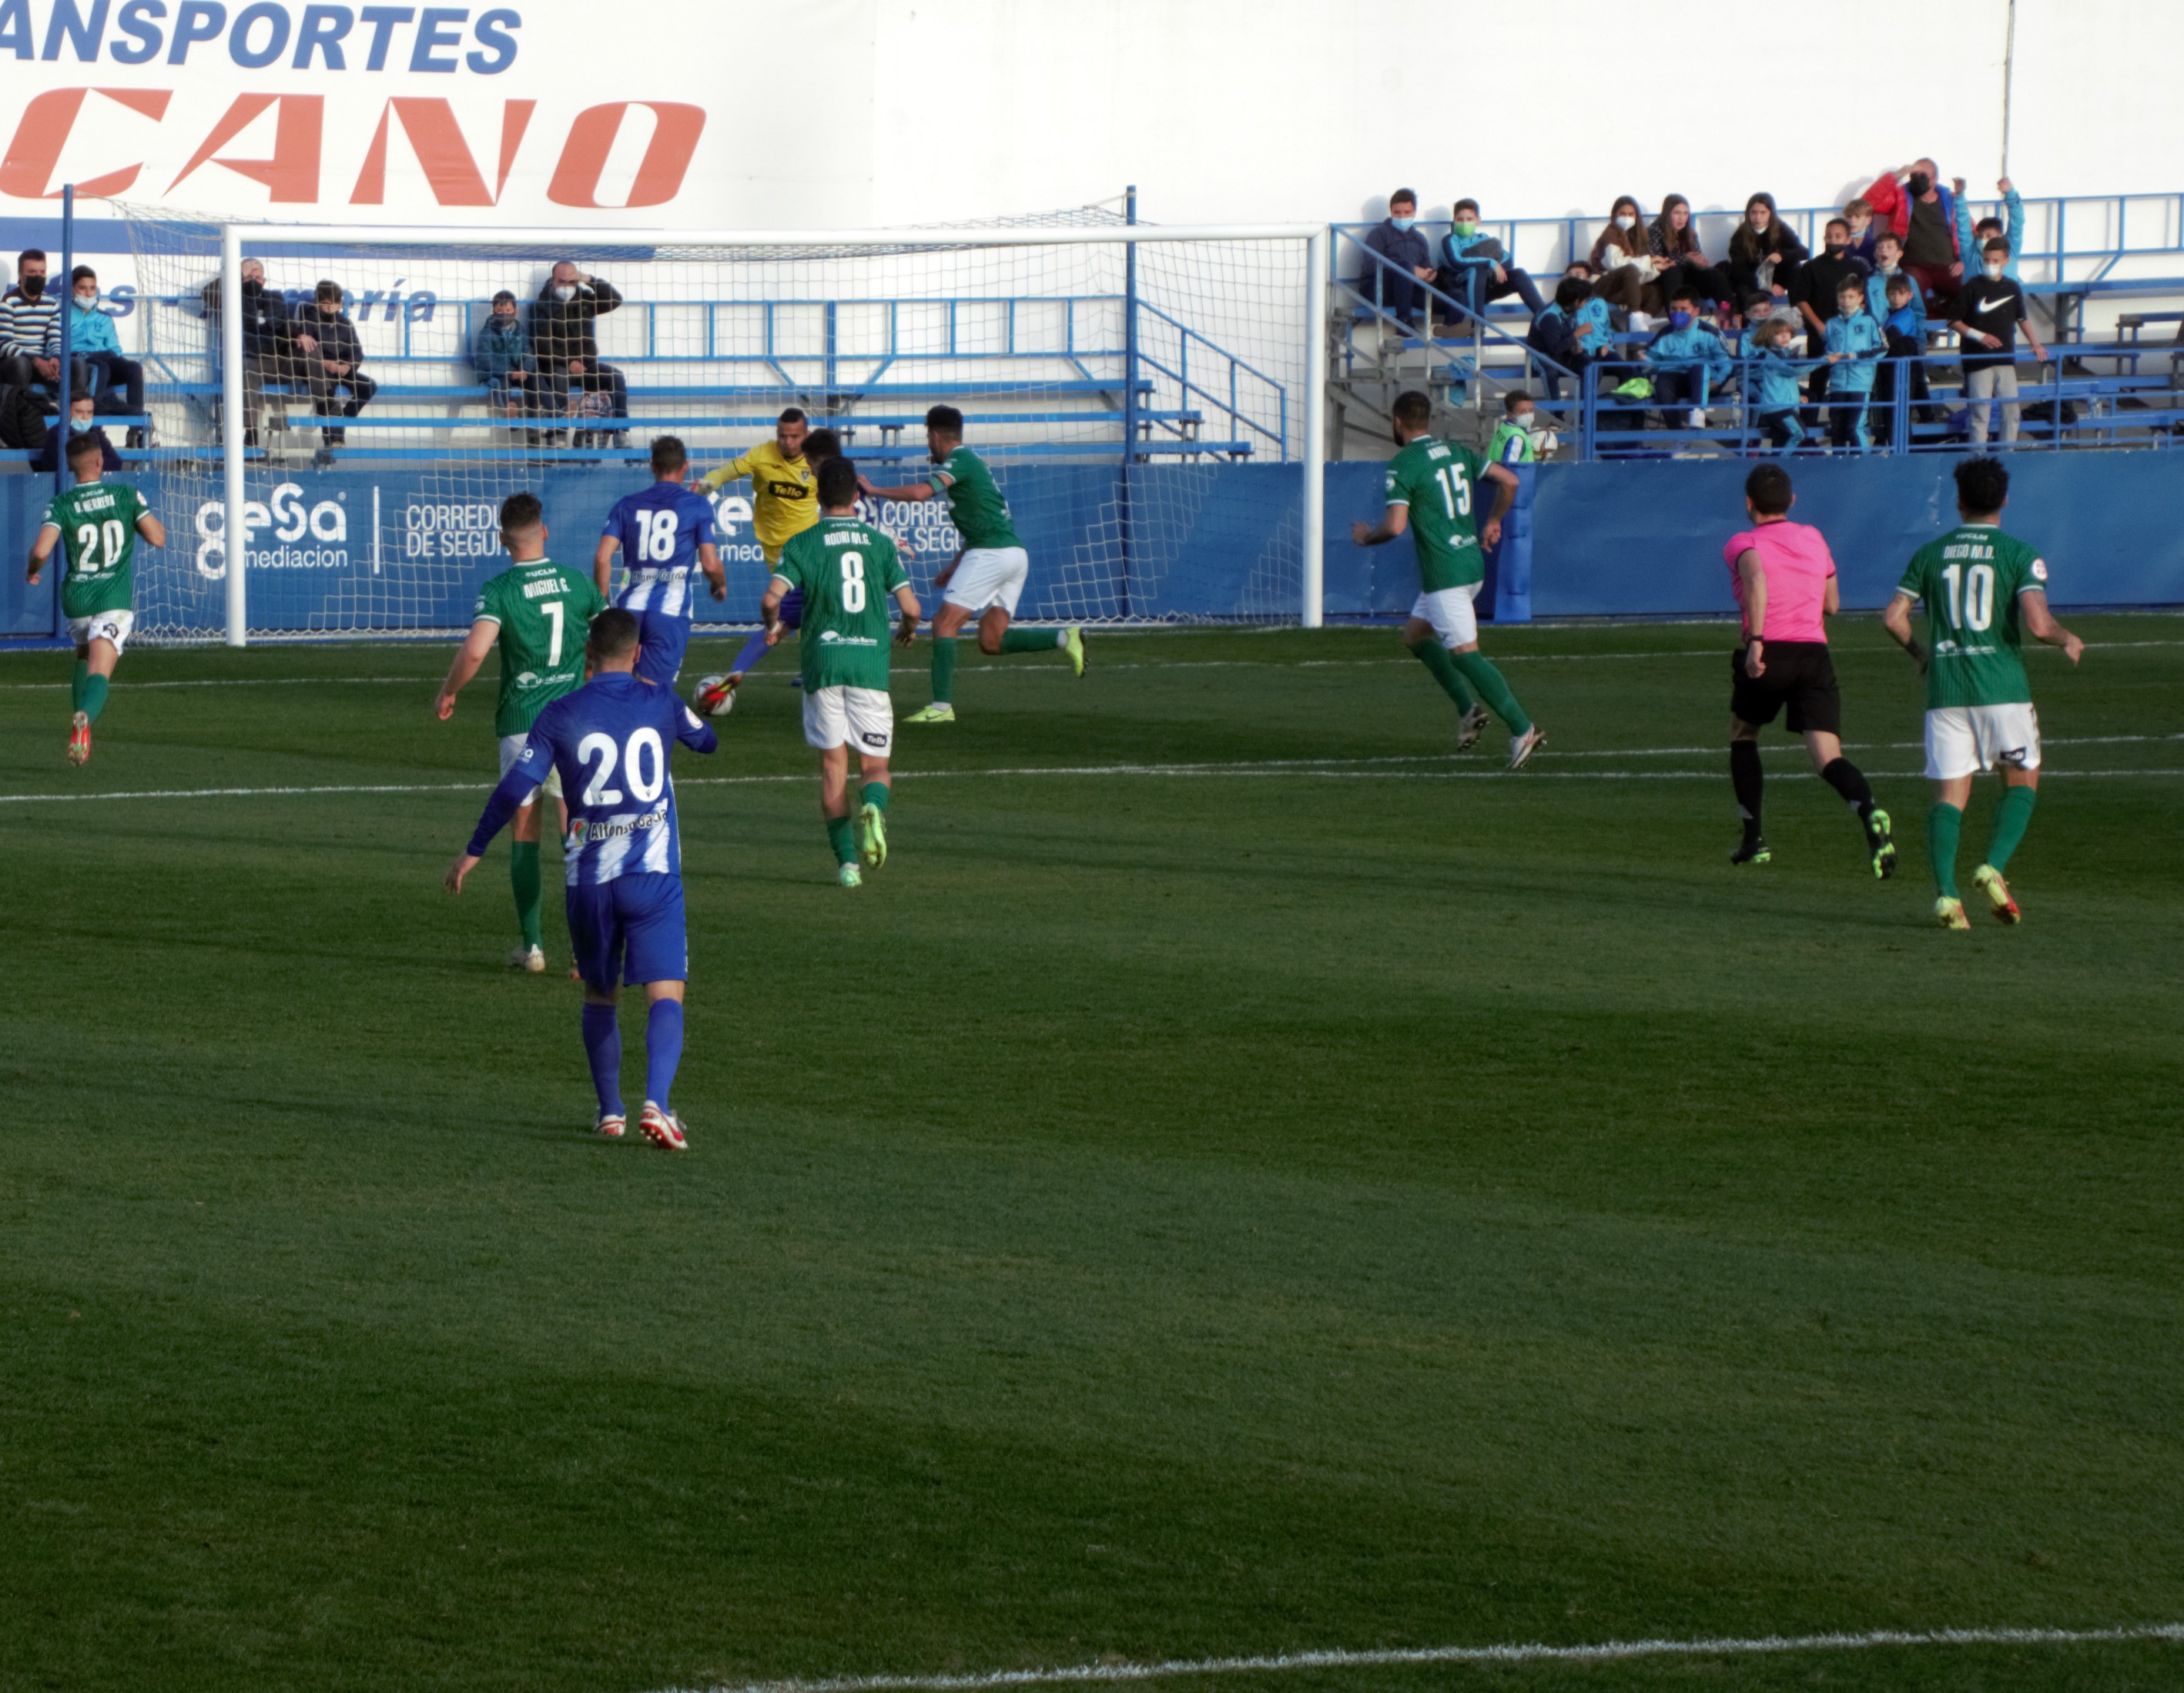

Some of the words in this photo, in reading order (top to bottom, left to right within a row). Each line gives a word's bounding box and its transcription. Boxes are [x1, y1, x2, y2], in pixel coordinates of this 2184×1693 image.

[0, 0, 522, 75] ANSPORTES
[0, 86, 707, 209] CANO
[774, 484, 803, 497] Tello
[883, 500, 954, 527] CORRE
[1435, 462, 1471, 520] 15
[78, 519, 125, 572] 20
[244, 544, 347, 567] mediacion
[406, 531, 435, 557] DE
[635, 509, 678, 561] 18
[824, 530, 850, 546] RODRI
[851, 531, 872, 545] M.G.
[1943, 544, 1970, 558] DIEGO
[524, 579, 561, 599] MIGUEL
[560, 577, 571, 592] G.
[840, 550, 866, 614] 8
[1941, 564, 1995, 631] 10
[541, 601, 564, 667] 7
[866, 734, 886, 745] Tello
[578, 727, 665, 806] 20
